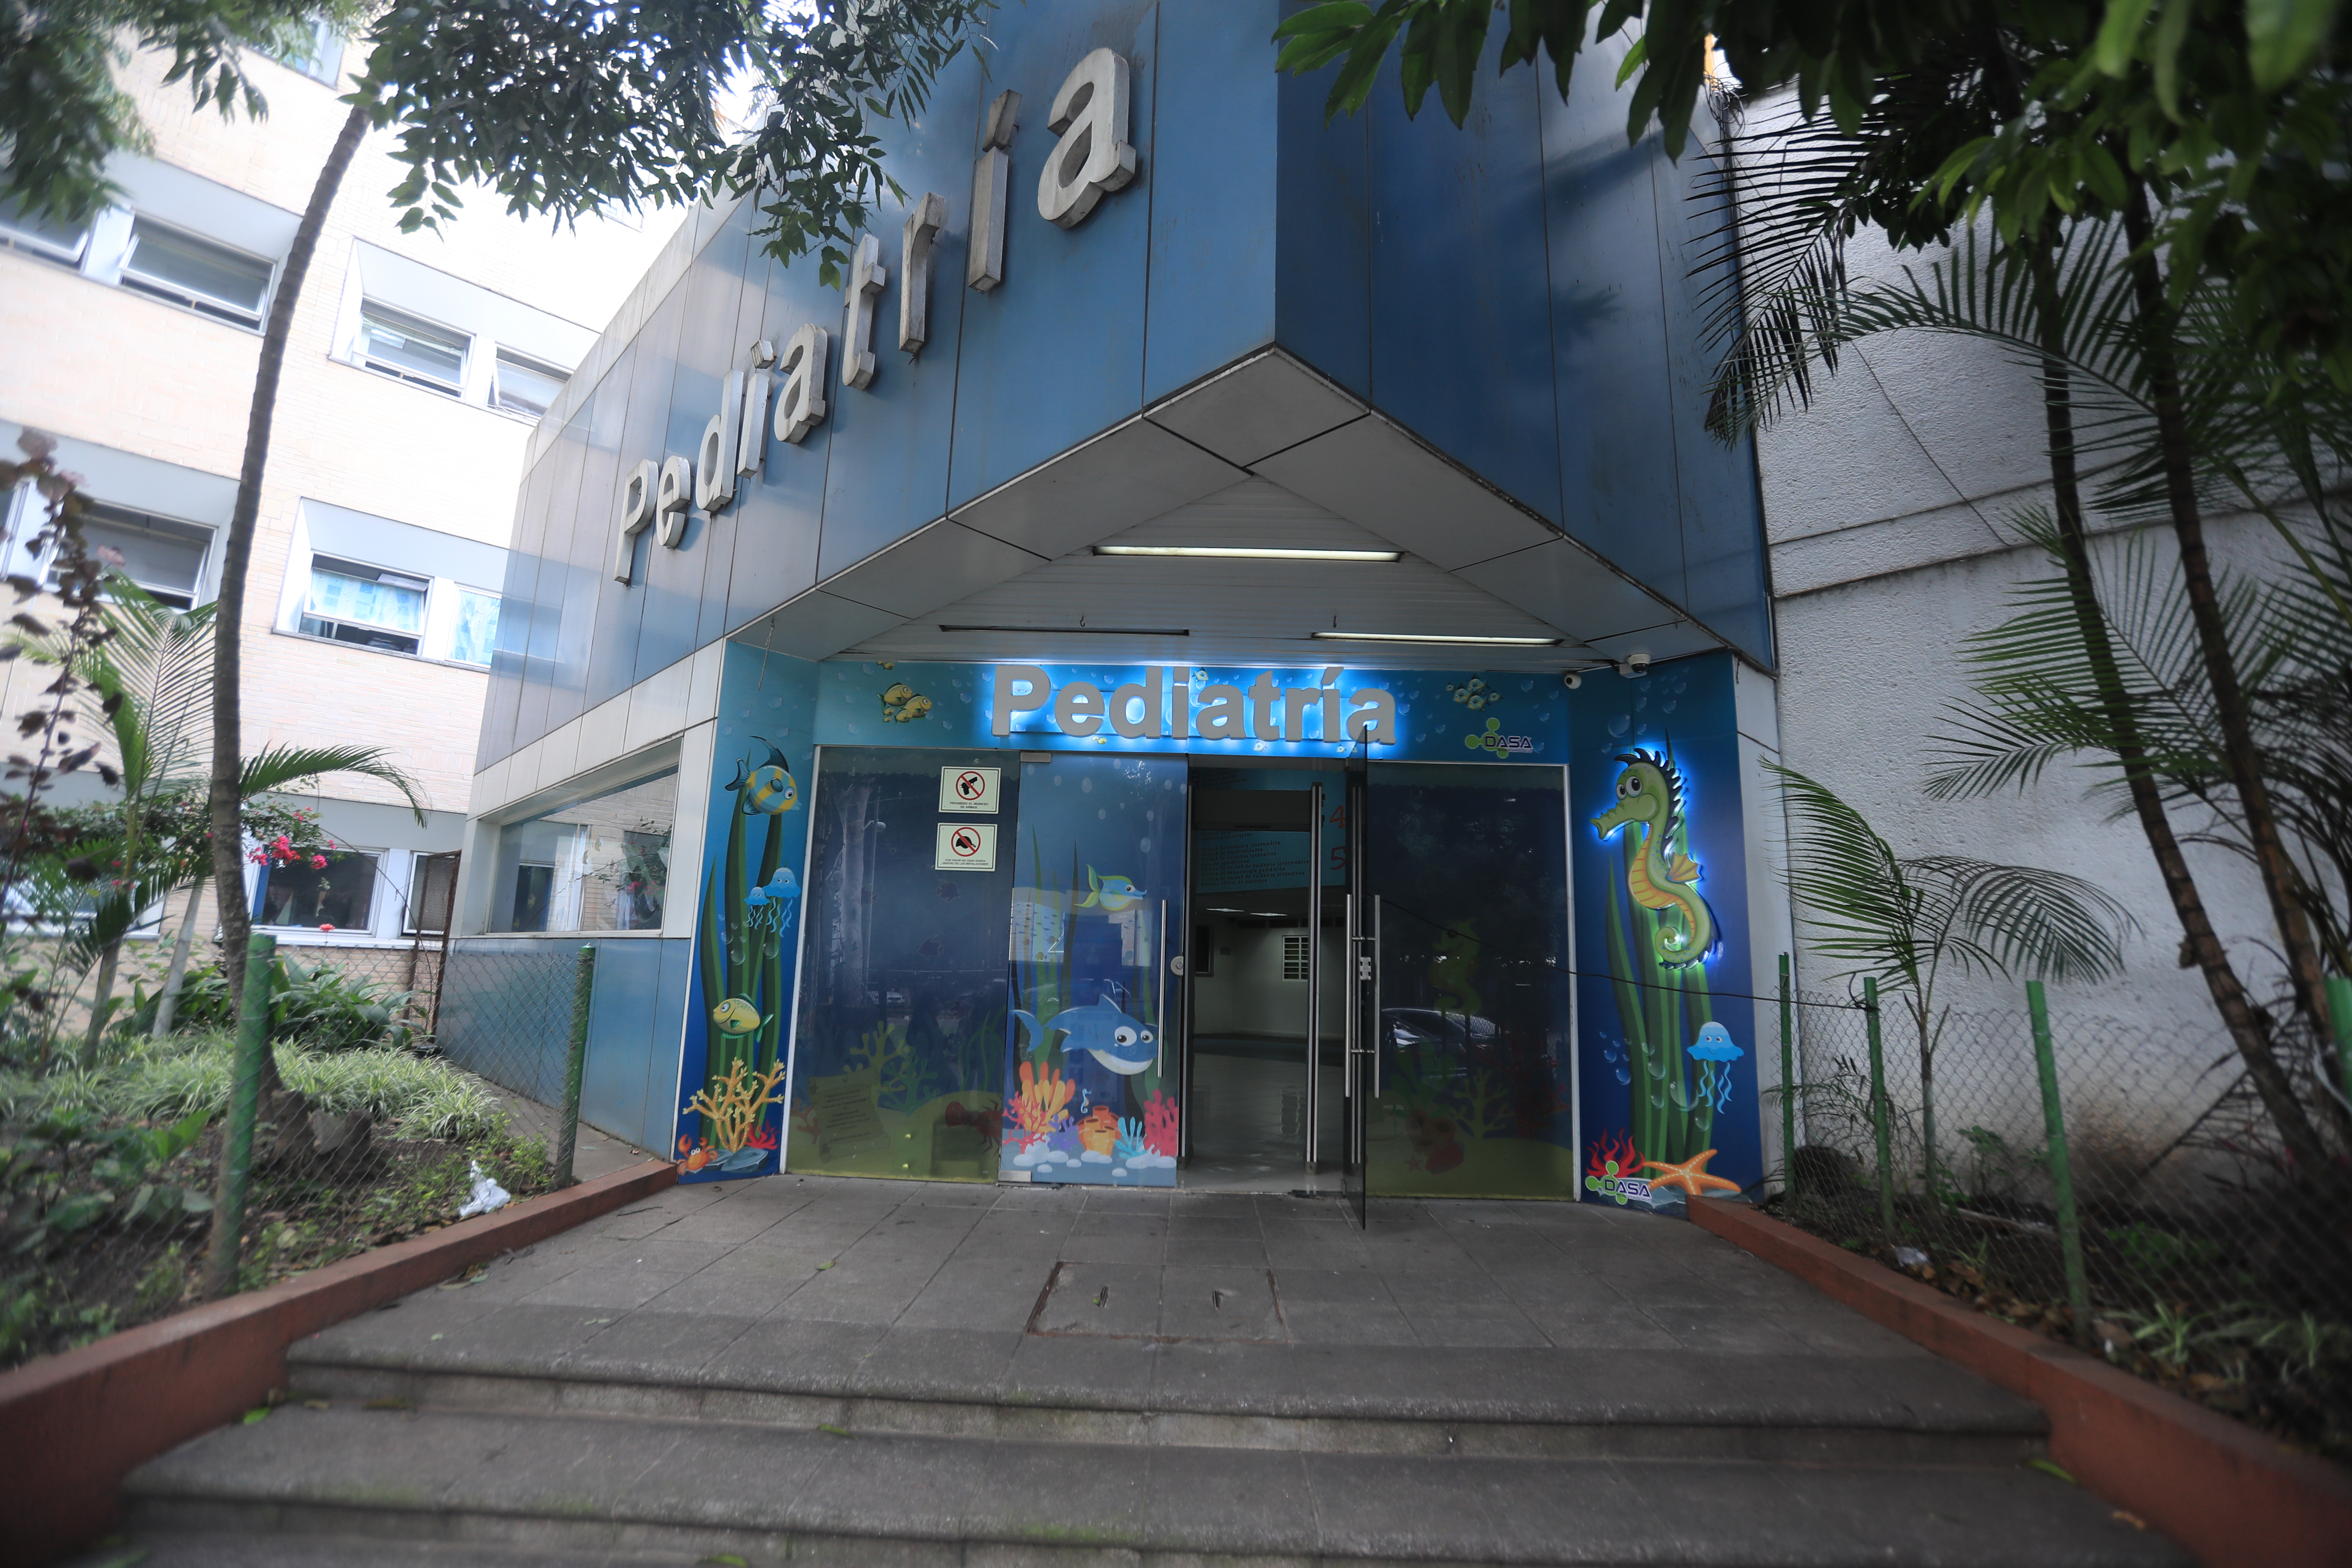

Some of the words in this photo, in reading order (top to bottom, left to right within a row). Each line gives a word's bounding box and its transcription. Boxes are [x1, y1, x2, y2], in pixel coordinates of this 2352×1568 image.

[614, 47, 1136, 583] Pediatría
[991, 665, 1396, 745] Pediatría
[1485, 735, 1533, 748] DASA
[1330, 805, 1346, 828] 4
[1330, 845, 1346, 870] 5
[1604, 1179, 1652, 1197] DASA
